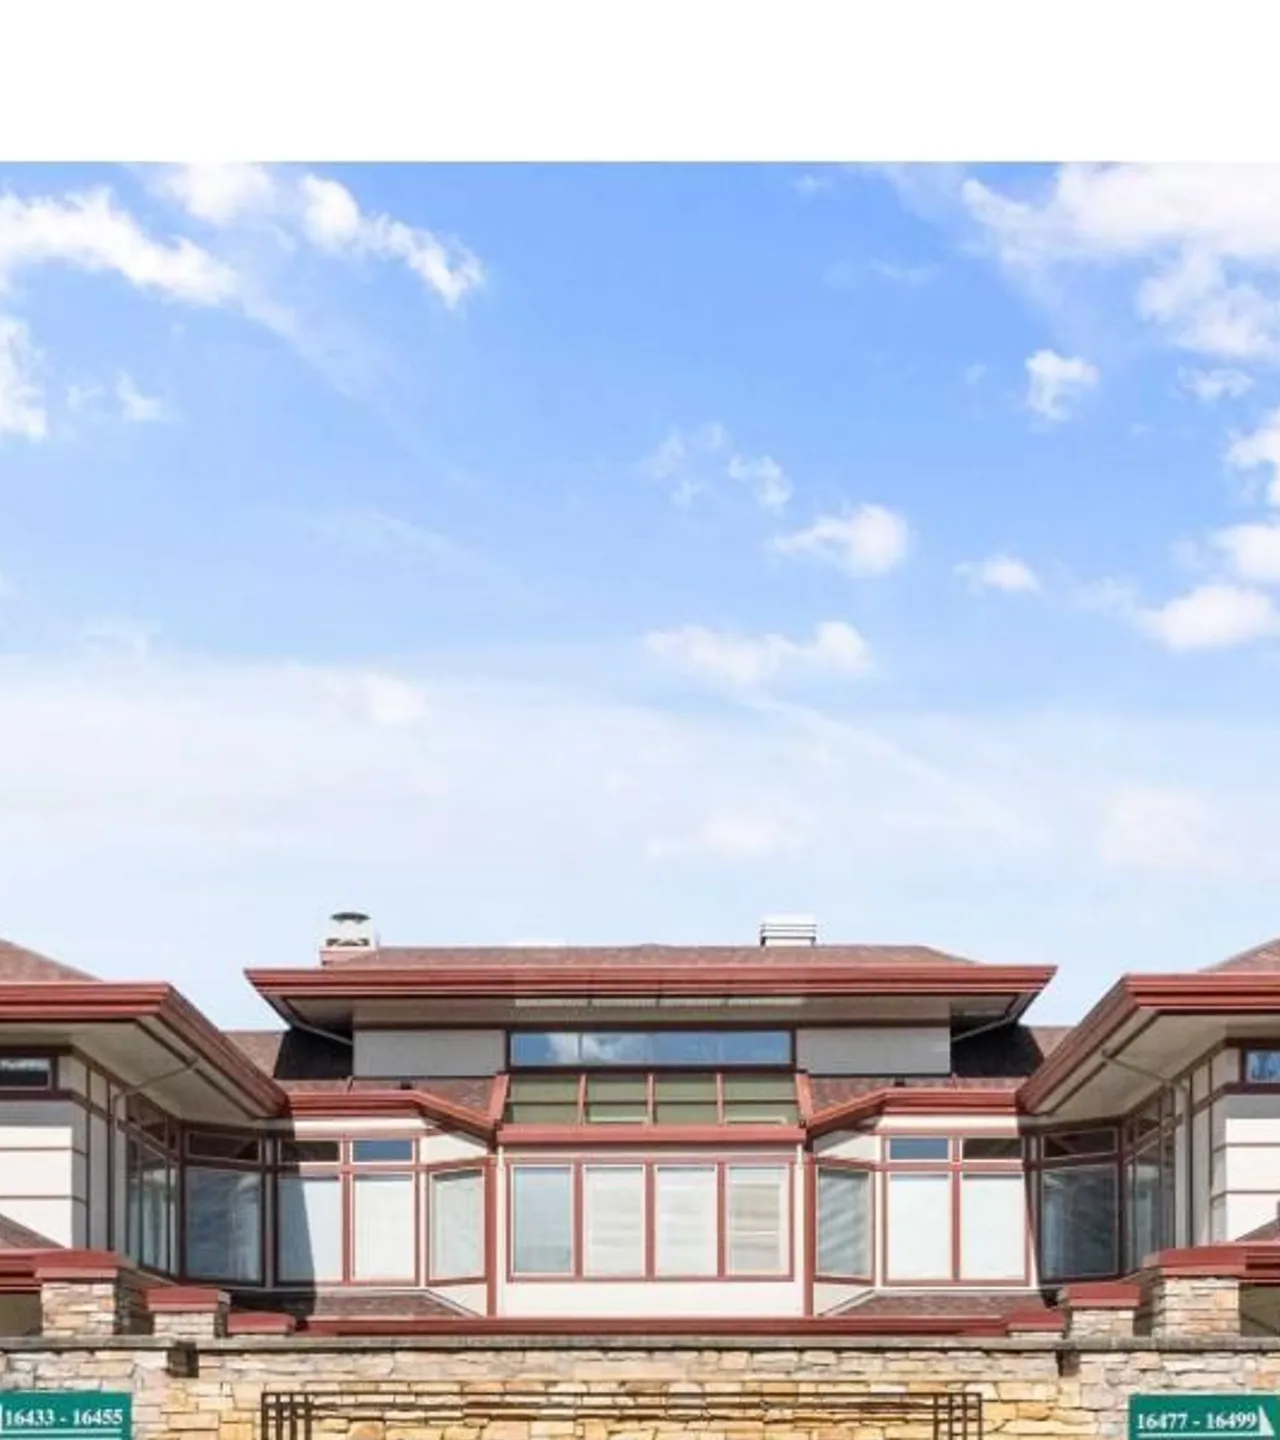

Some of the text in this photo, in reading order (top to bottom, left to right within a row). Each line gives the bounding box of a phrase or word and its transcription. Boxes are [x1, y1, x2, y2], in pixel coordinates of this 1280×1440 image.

[5, 1409, 54, 1426] 16433
[73, 1409, 123, 1425] 16455
[1137, 1413, 1188, 1429] 16477
[1206, 1413, 1257, 1429] 16499
